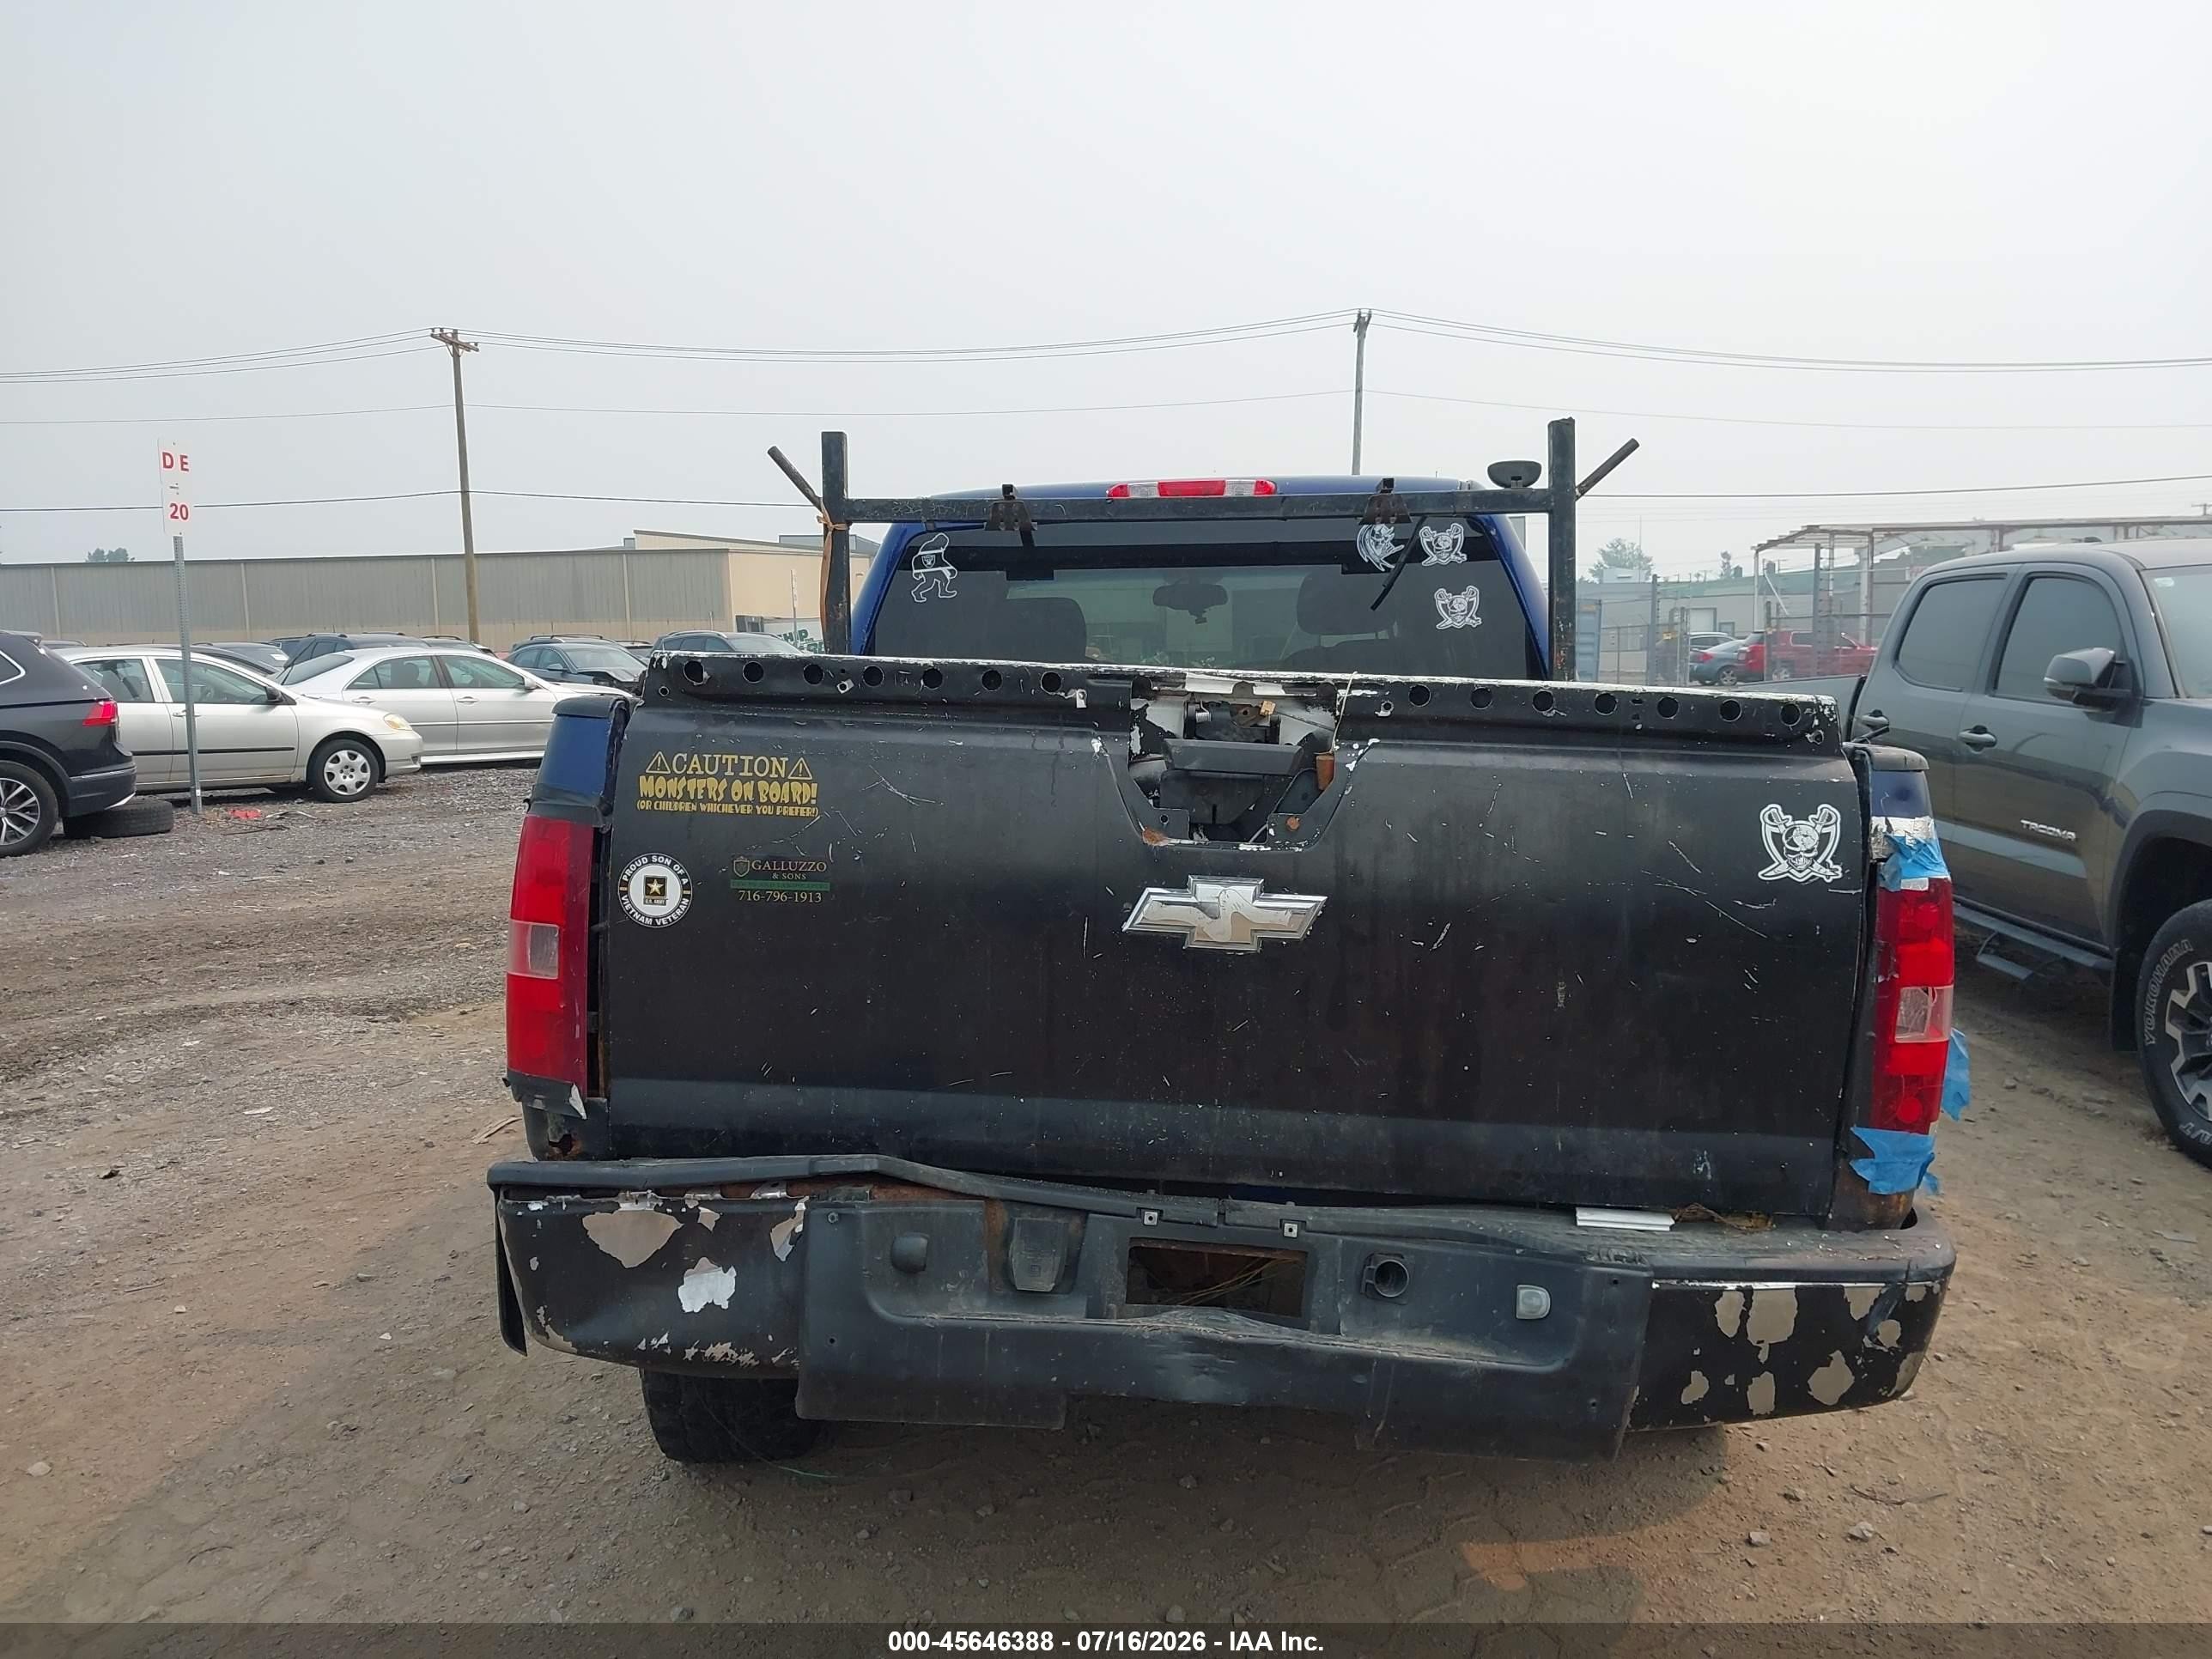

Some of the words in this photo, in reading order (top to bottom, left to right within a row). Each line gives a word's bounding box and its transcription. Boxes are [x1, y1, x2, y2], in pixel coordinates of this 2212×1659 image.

[161, 452, 174, 469] D
[179, 454, 190, 472] E
[169, 502, 189, 520] 20
[672, 753, 788, 778] CAUTION
[639, 775, 727, 802] MONSTERS
[731, 779, 755, 803] ON
[757, 781, 818, 805] BOARD!
[636, 799, 652, 811] (OR
[653, 799, 697, 812] CHILDREN
[700, 802, 753, 815] WHICHEVER
[756, 805, 774, 815] YOU
[776, 805, 818, 817] PREFER!)
[2021, 819, 2076, 841] TACOMA
[622, 856, 648, 882] PROUD
[652, 855, 672, 866] SON
[673, 864, 686, 876] OF
[751, 860, 827, 872] GALLUZZO
[738, 890, 822, 903] 716-796-1913
[621, 894, 653, 925] VIETNAM
[655, 897, 690, 926] VETERAN
[2143, 938, 2194, 1047] YOKOHAMA
